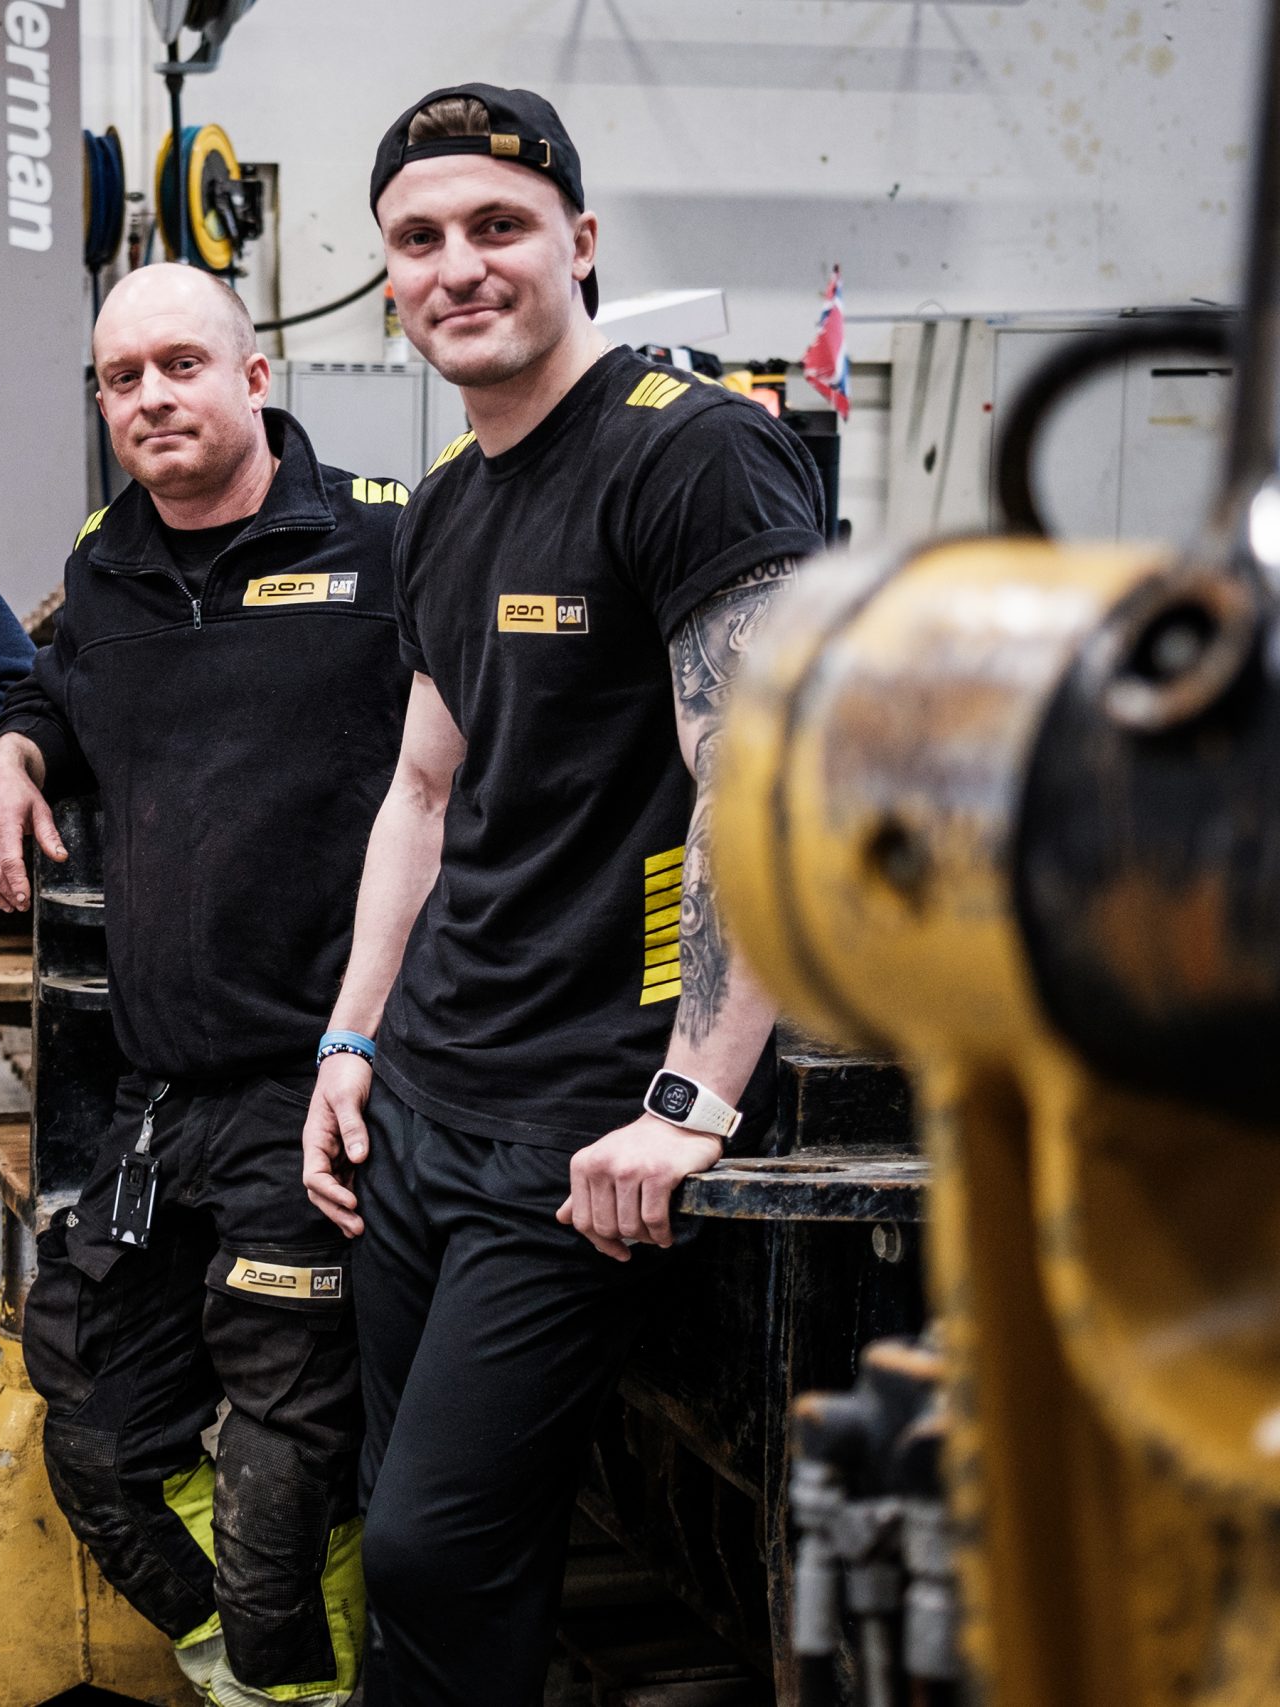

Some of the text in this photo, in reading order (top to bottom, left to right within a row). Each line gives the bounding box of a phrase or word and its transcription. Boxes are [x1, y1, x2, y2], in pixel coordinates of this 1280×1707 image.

[5, 0, 66, 252] erman
[258, 580, 354, 597] pon CAT
[505, 605, 583, 624] pon CAT
[241, 1269, 337, 1290] pon CAT
